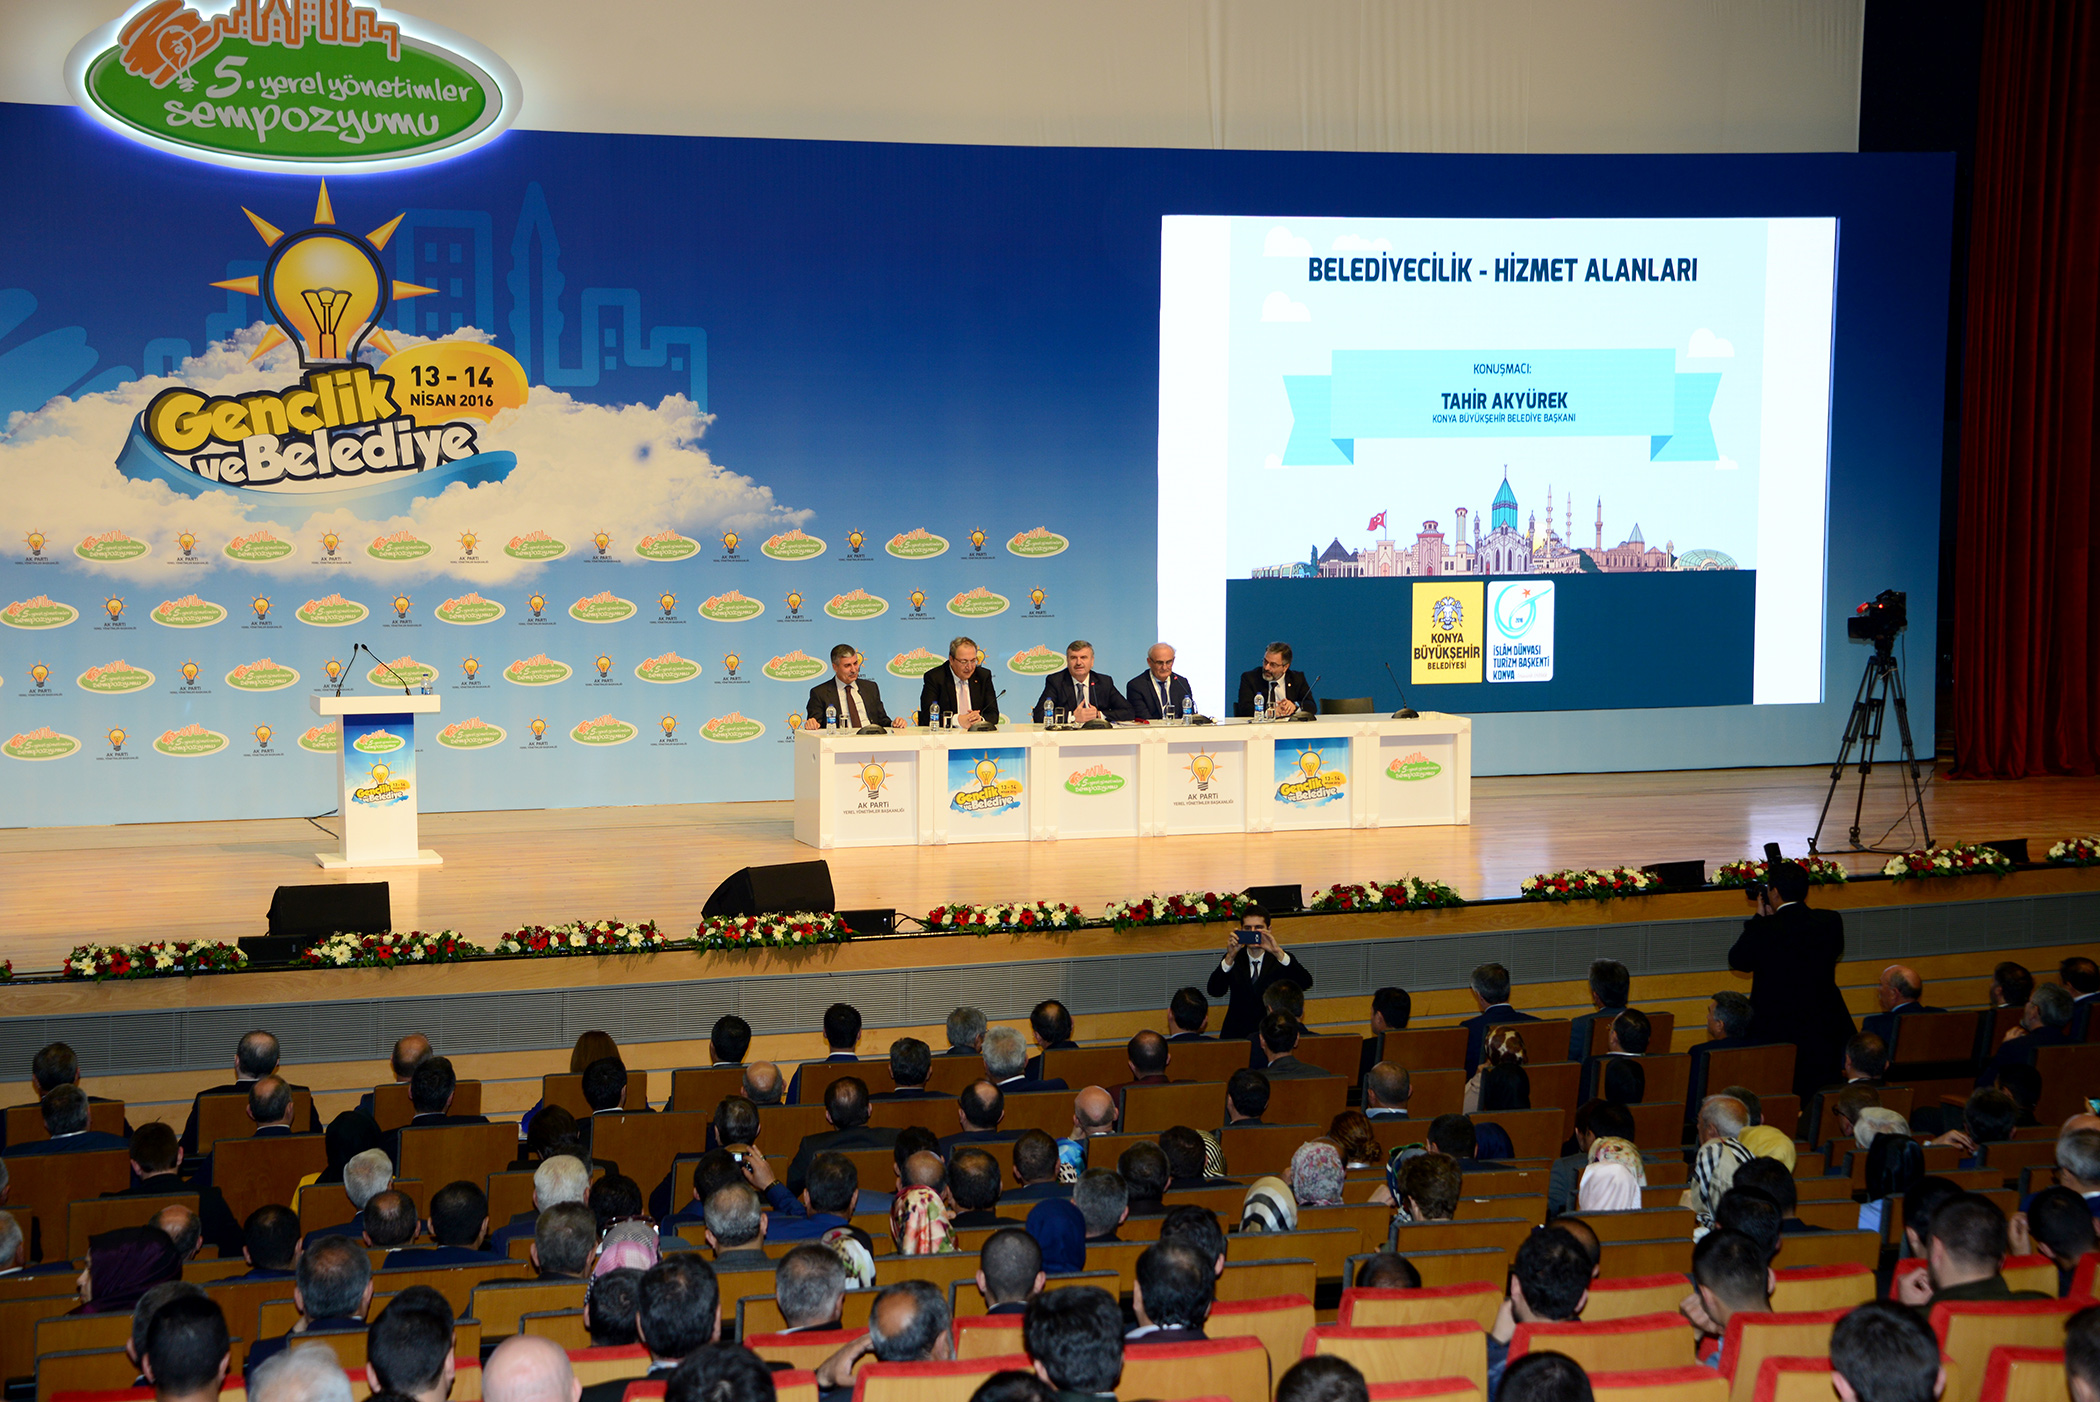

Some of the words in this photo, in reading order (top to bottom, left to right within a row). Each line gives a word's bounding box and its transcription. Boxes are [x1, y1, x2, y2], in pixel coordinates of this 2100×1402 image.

[259, 72, 323, 99] yerel
[328, 74, 473, 102] yönetimler
[164, 100, 439, 144] sempozyumu
[1309, 252, 1472, 282] BELEDİYECİLİK
[1495, 252, 1578, 282] HİZMET
[1584, 257, 1698, 282] ALANLARI
[410, 366, 440, 387] 13
[465, 366, 494, 387] 14
[1473, 363, 1531, 376] KONUŞMACI:
[410, 391, 456, 407] NİSAN
[460, 395, 494, 407] 2016
[1441, 388, 1487, 409] TAHİR
[1492, 388, 1568, 409] AKYÜREK
[1433, 414, 1457, 423] KONYA
[196, 456, 246, 483] ve
[243, 419, 475, 481] Belediye
[1431, 633, 1463, 643] KONYA
[1414, 644, 1480, 660] BÜYÜKŞEHİR
[1427, 660, 1466, 670] BELEDİYESİ
[1493, 670, 1515, 680] KONYA
